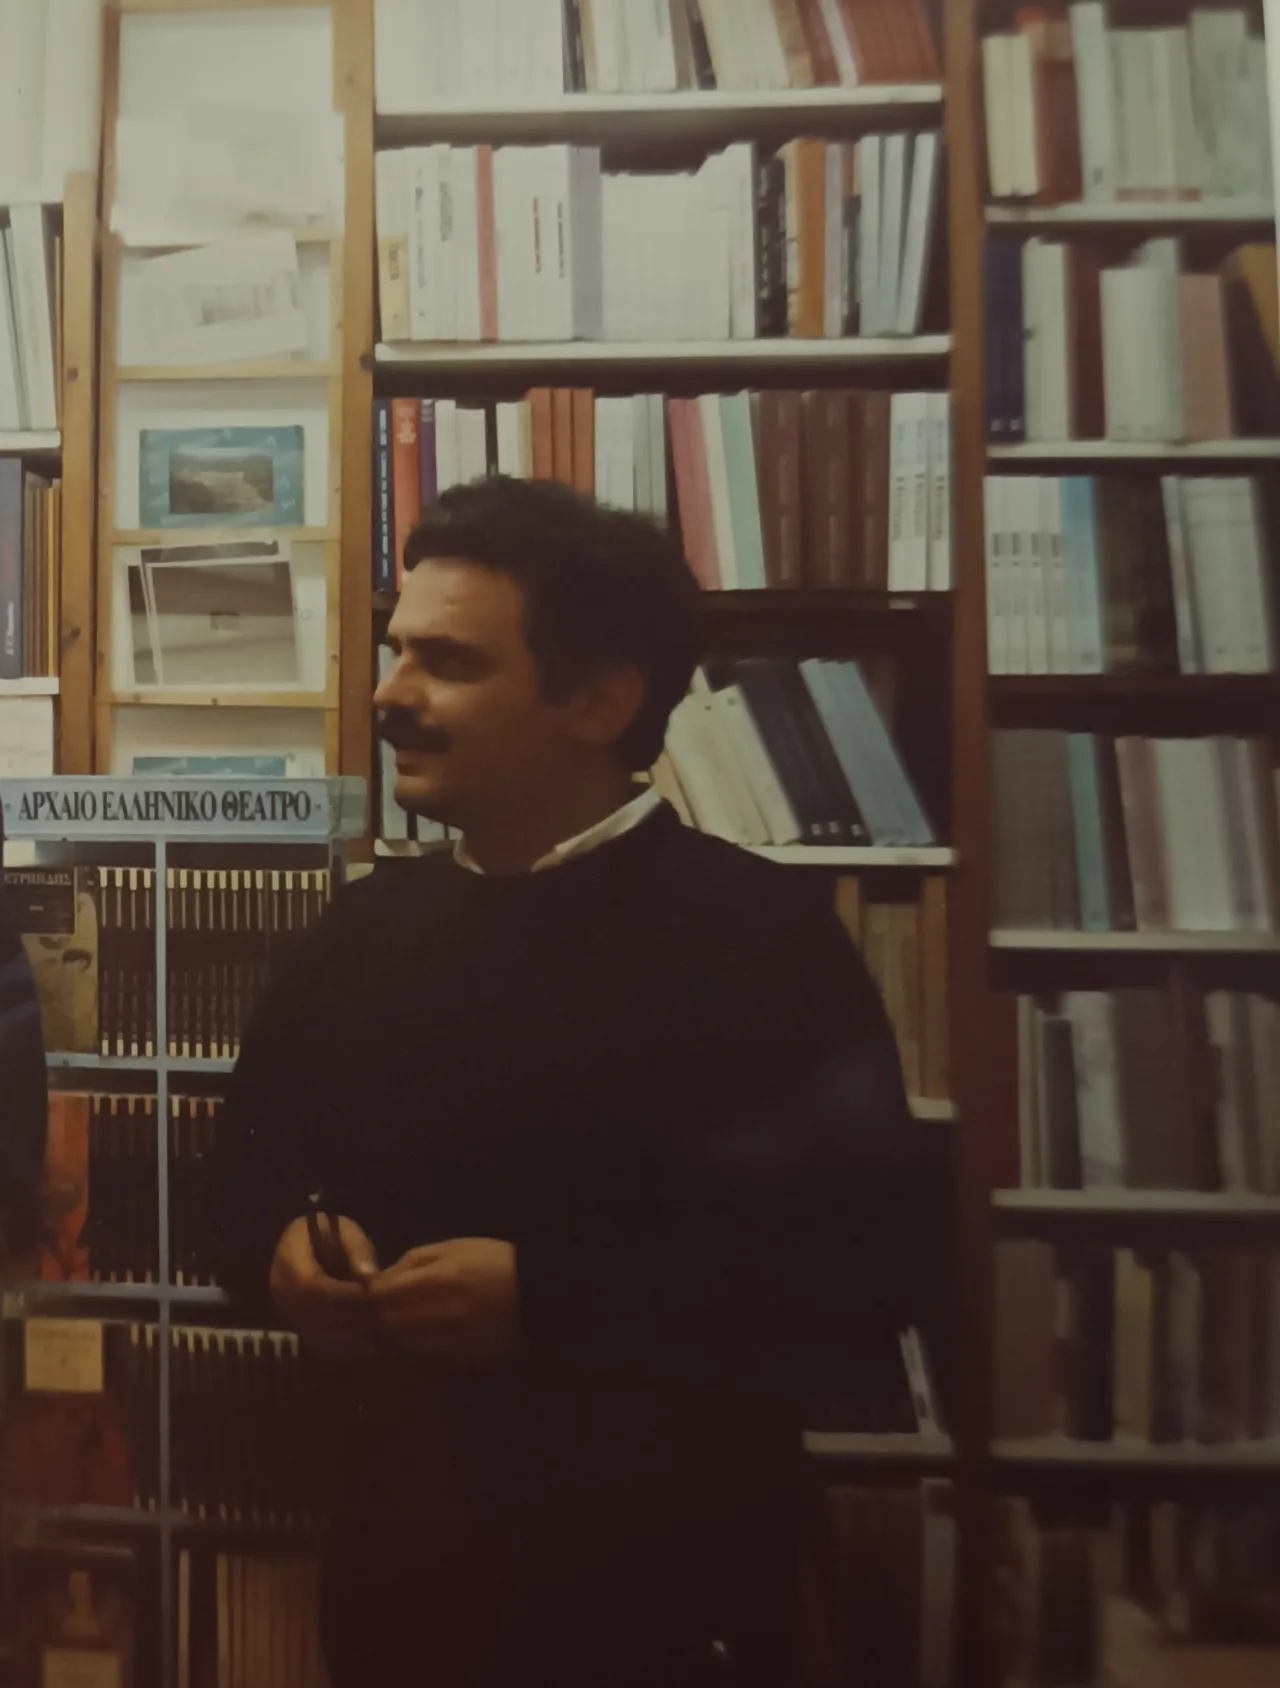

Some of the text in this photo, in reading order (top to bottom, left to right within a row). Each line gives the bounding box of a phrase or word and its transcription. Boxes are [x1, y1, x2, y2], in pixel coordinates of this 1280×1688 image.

[18, 790, 312, 821] ΑΡΧΑΙΟ ΕΛΛΗΝΙΚΟ ΘΕΑΤΡΟ
